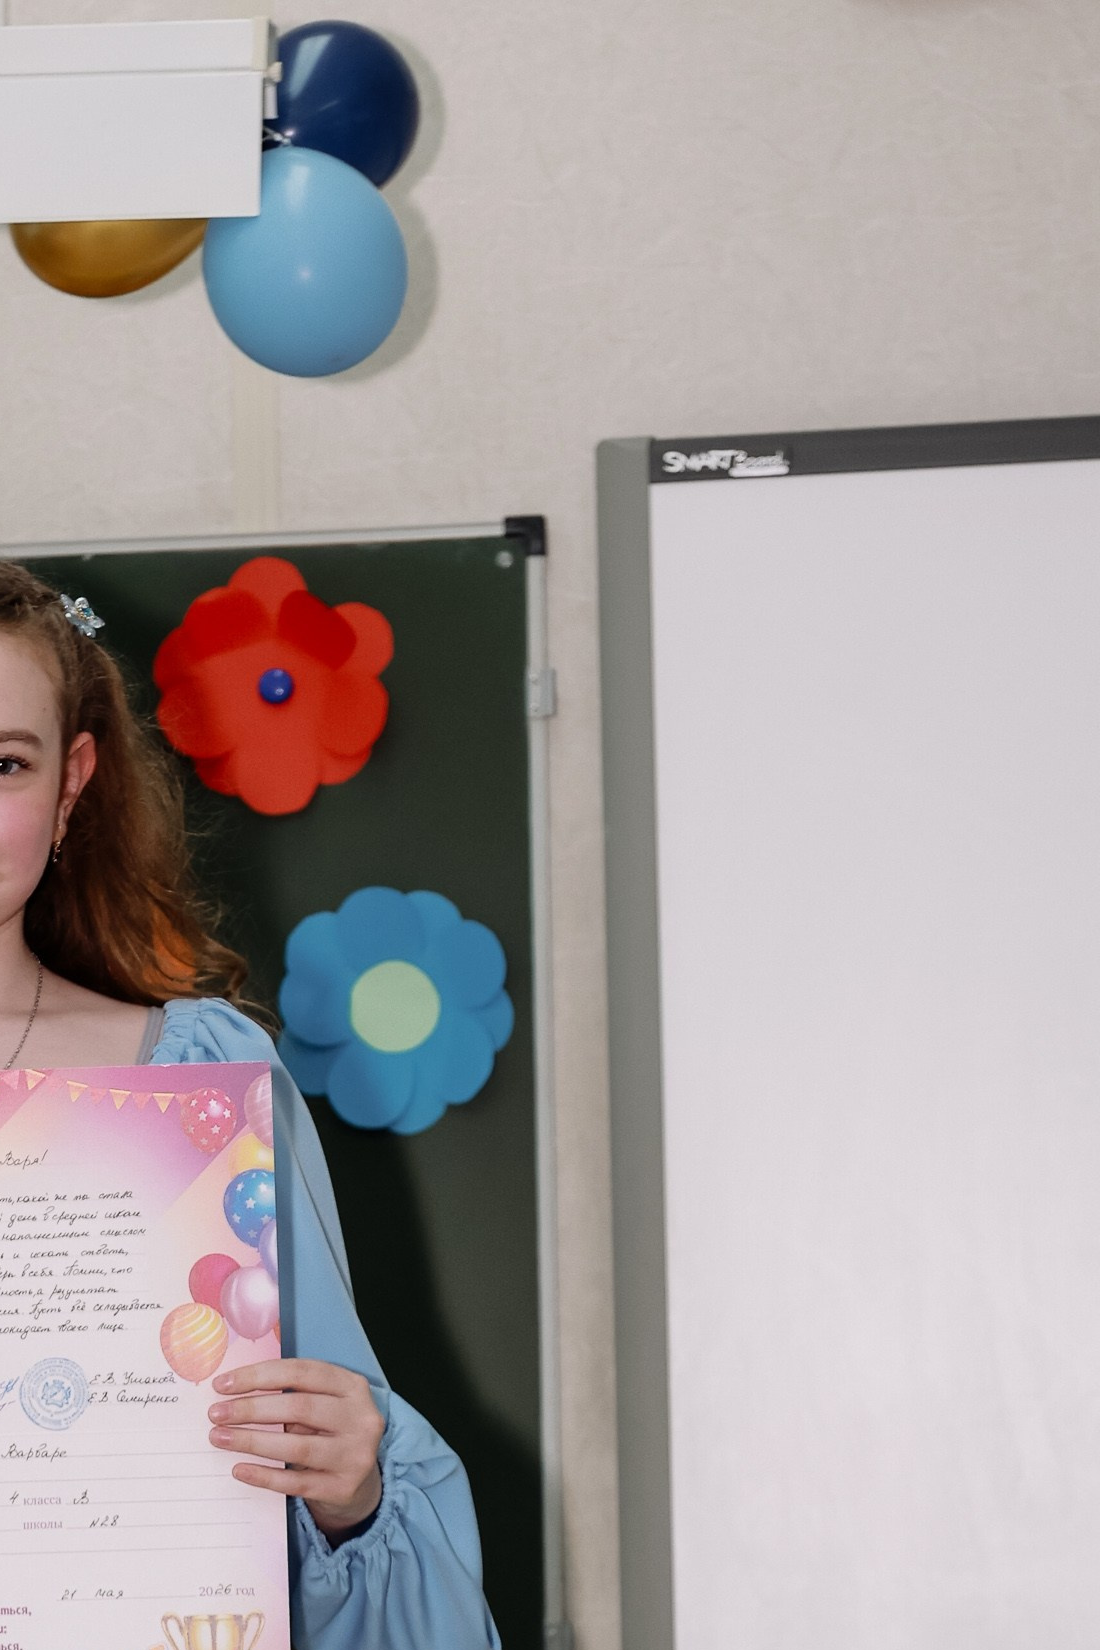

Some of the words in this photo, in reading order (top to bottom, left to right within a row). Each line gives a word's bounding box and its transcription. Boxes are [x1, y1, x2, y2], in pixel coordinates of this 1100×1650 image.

[0, 1149, 48, 1170] Варя!
[23, 1495, 62, 1506] класса
[23, 1520, 63, 1530] школы
[95, 1588, 124, 1599] мая
[235, 1587, 256, 1597] год
